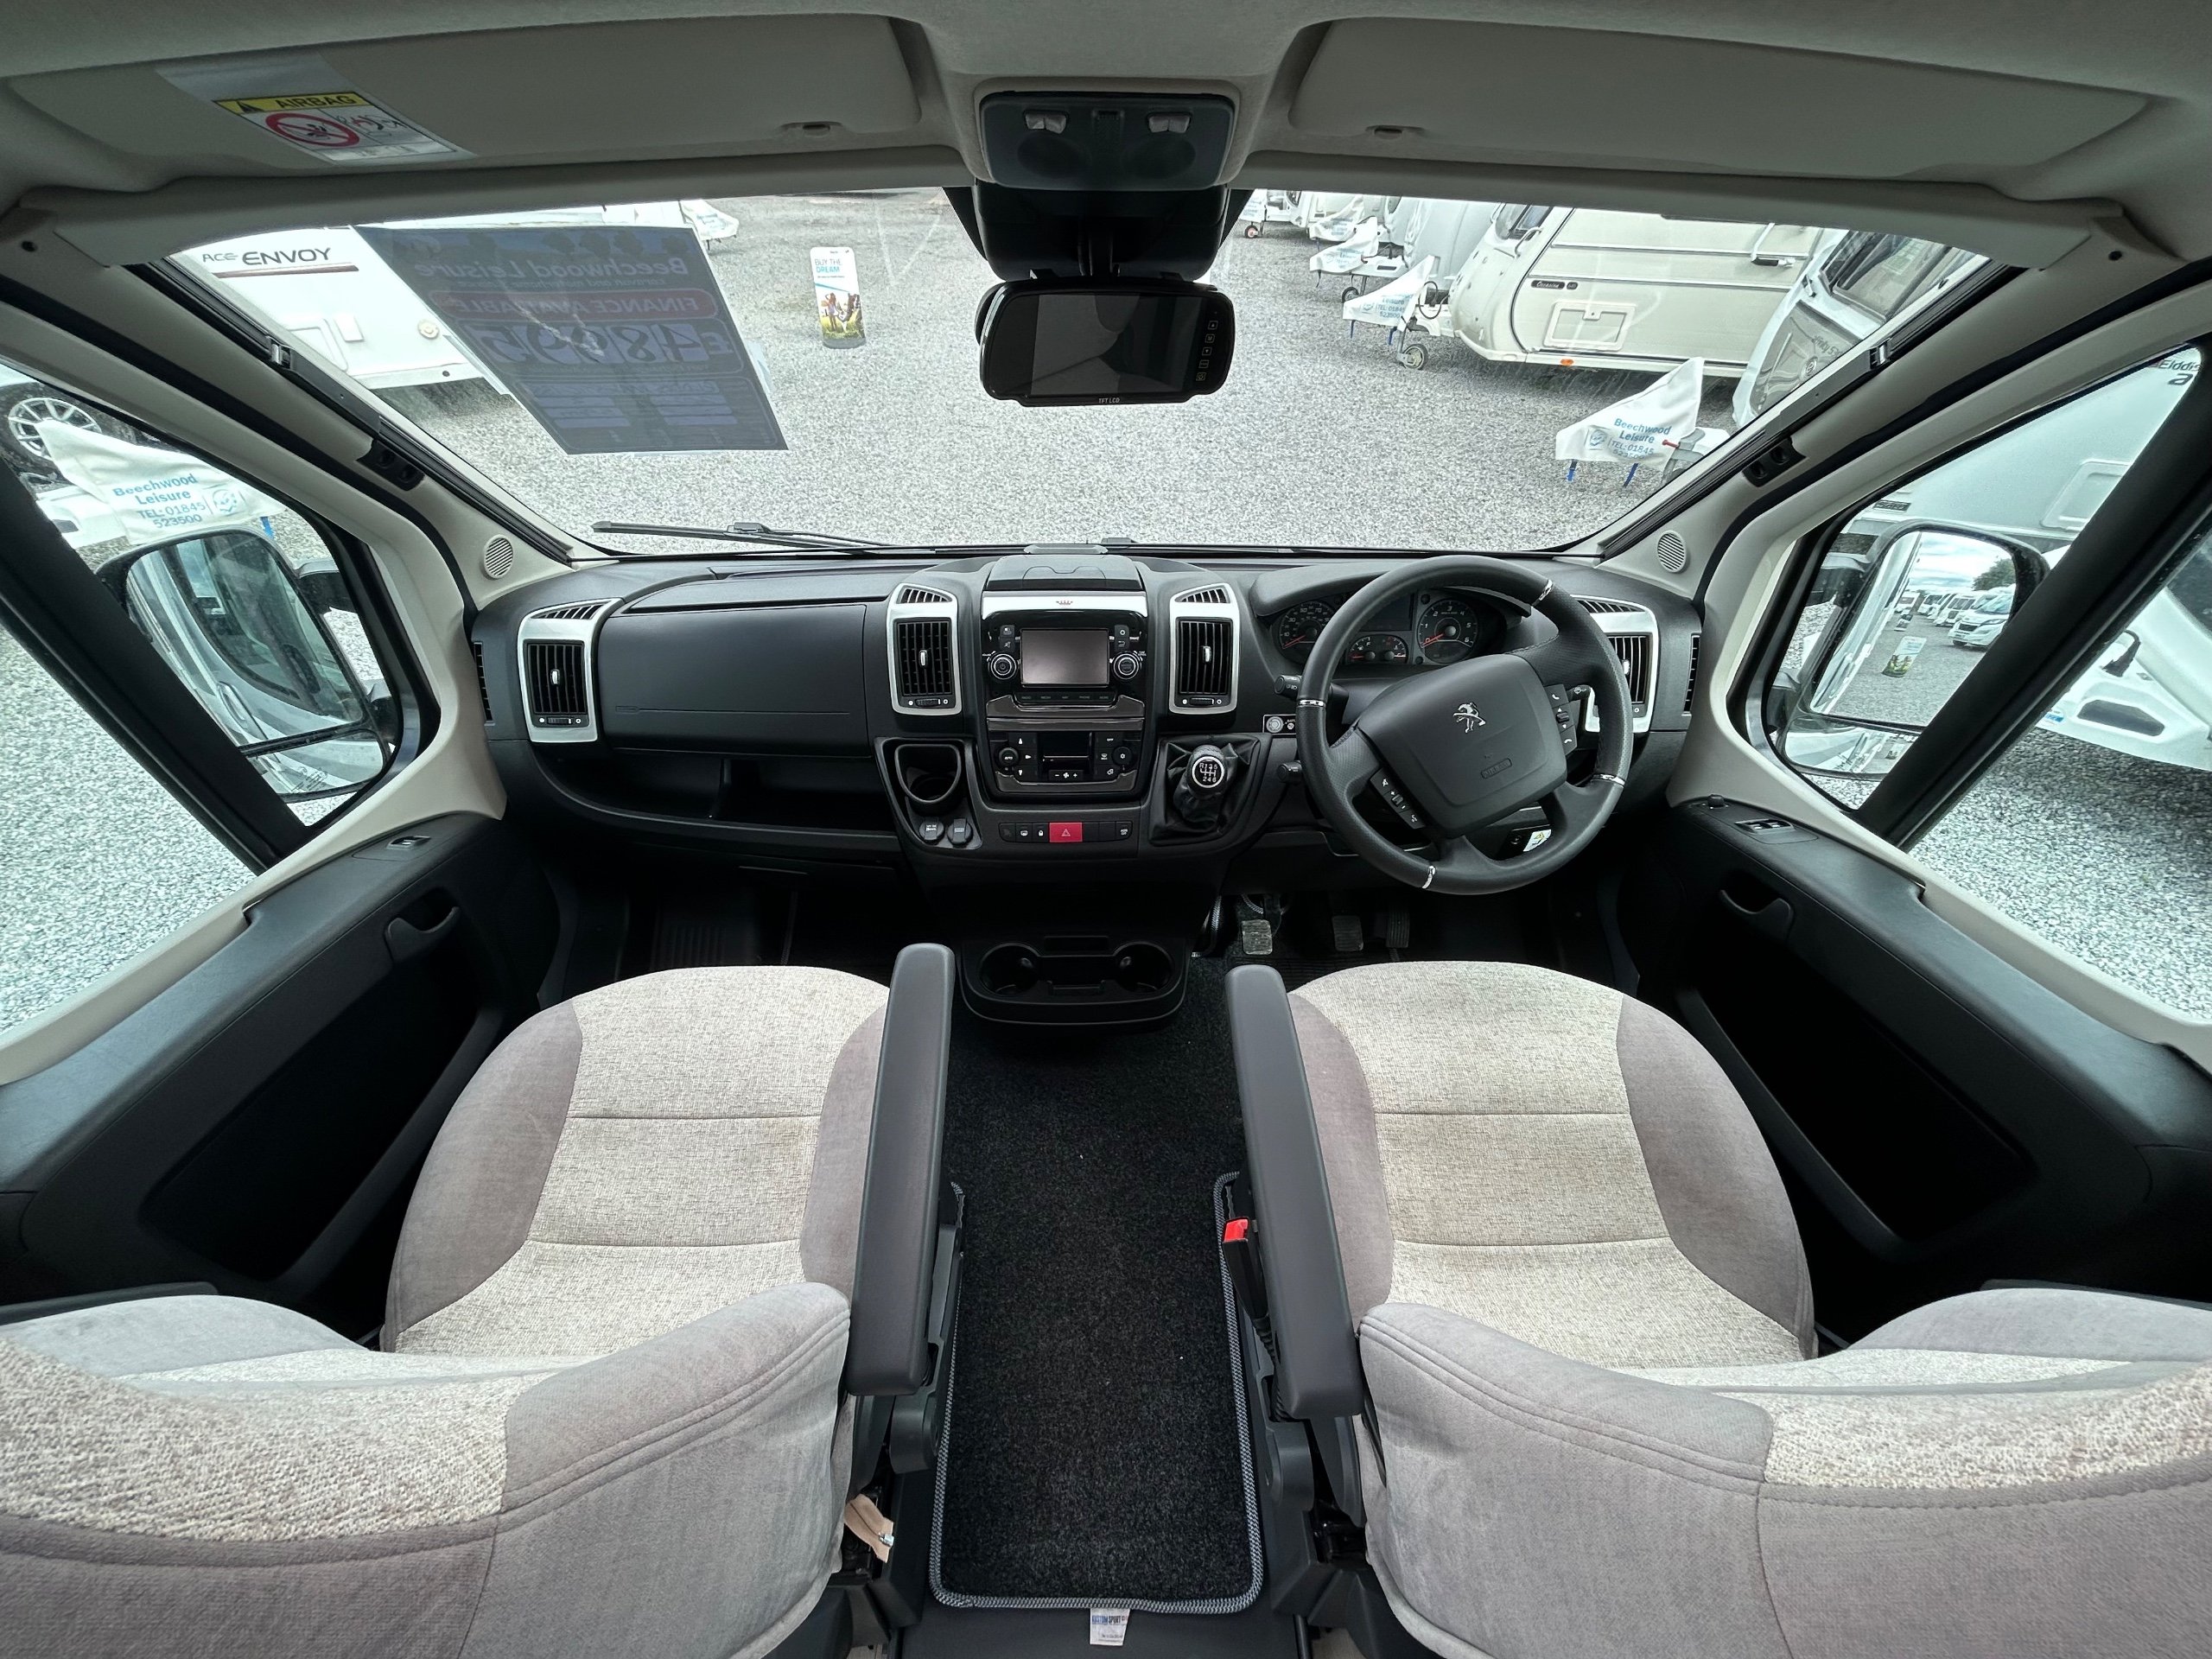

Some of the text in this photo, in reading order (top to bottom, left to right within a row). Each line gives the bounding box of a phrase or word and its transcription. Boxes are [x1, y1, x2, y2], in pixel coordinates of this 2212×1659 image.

[276, 95, 358, 109] AIRBAG
[202, 247, 331, 265] ACE ENVOY
[1614, 417, 1673, 435] Beechwood
[1619, 432, 1656, 443] Leisure
[112, 474, 199, 497] Beechwood
[136, 490, 191, 505] Leisure
[165, 502, 207, 516] 01845
[153, 514, 203, 529] 523500
